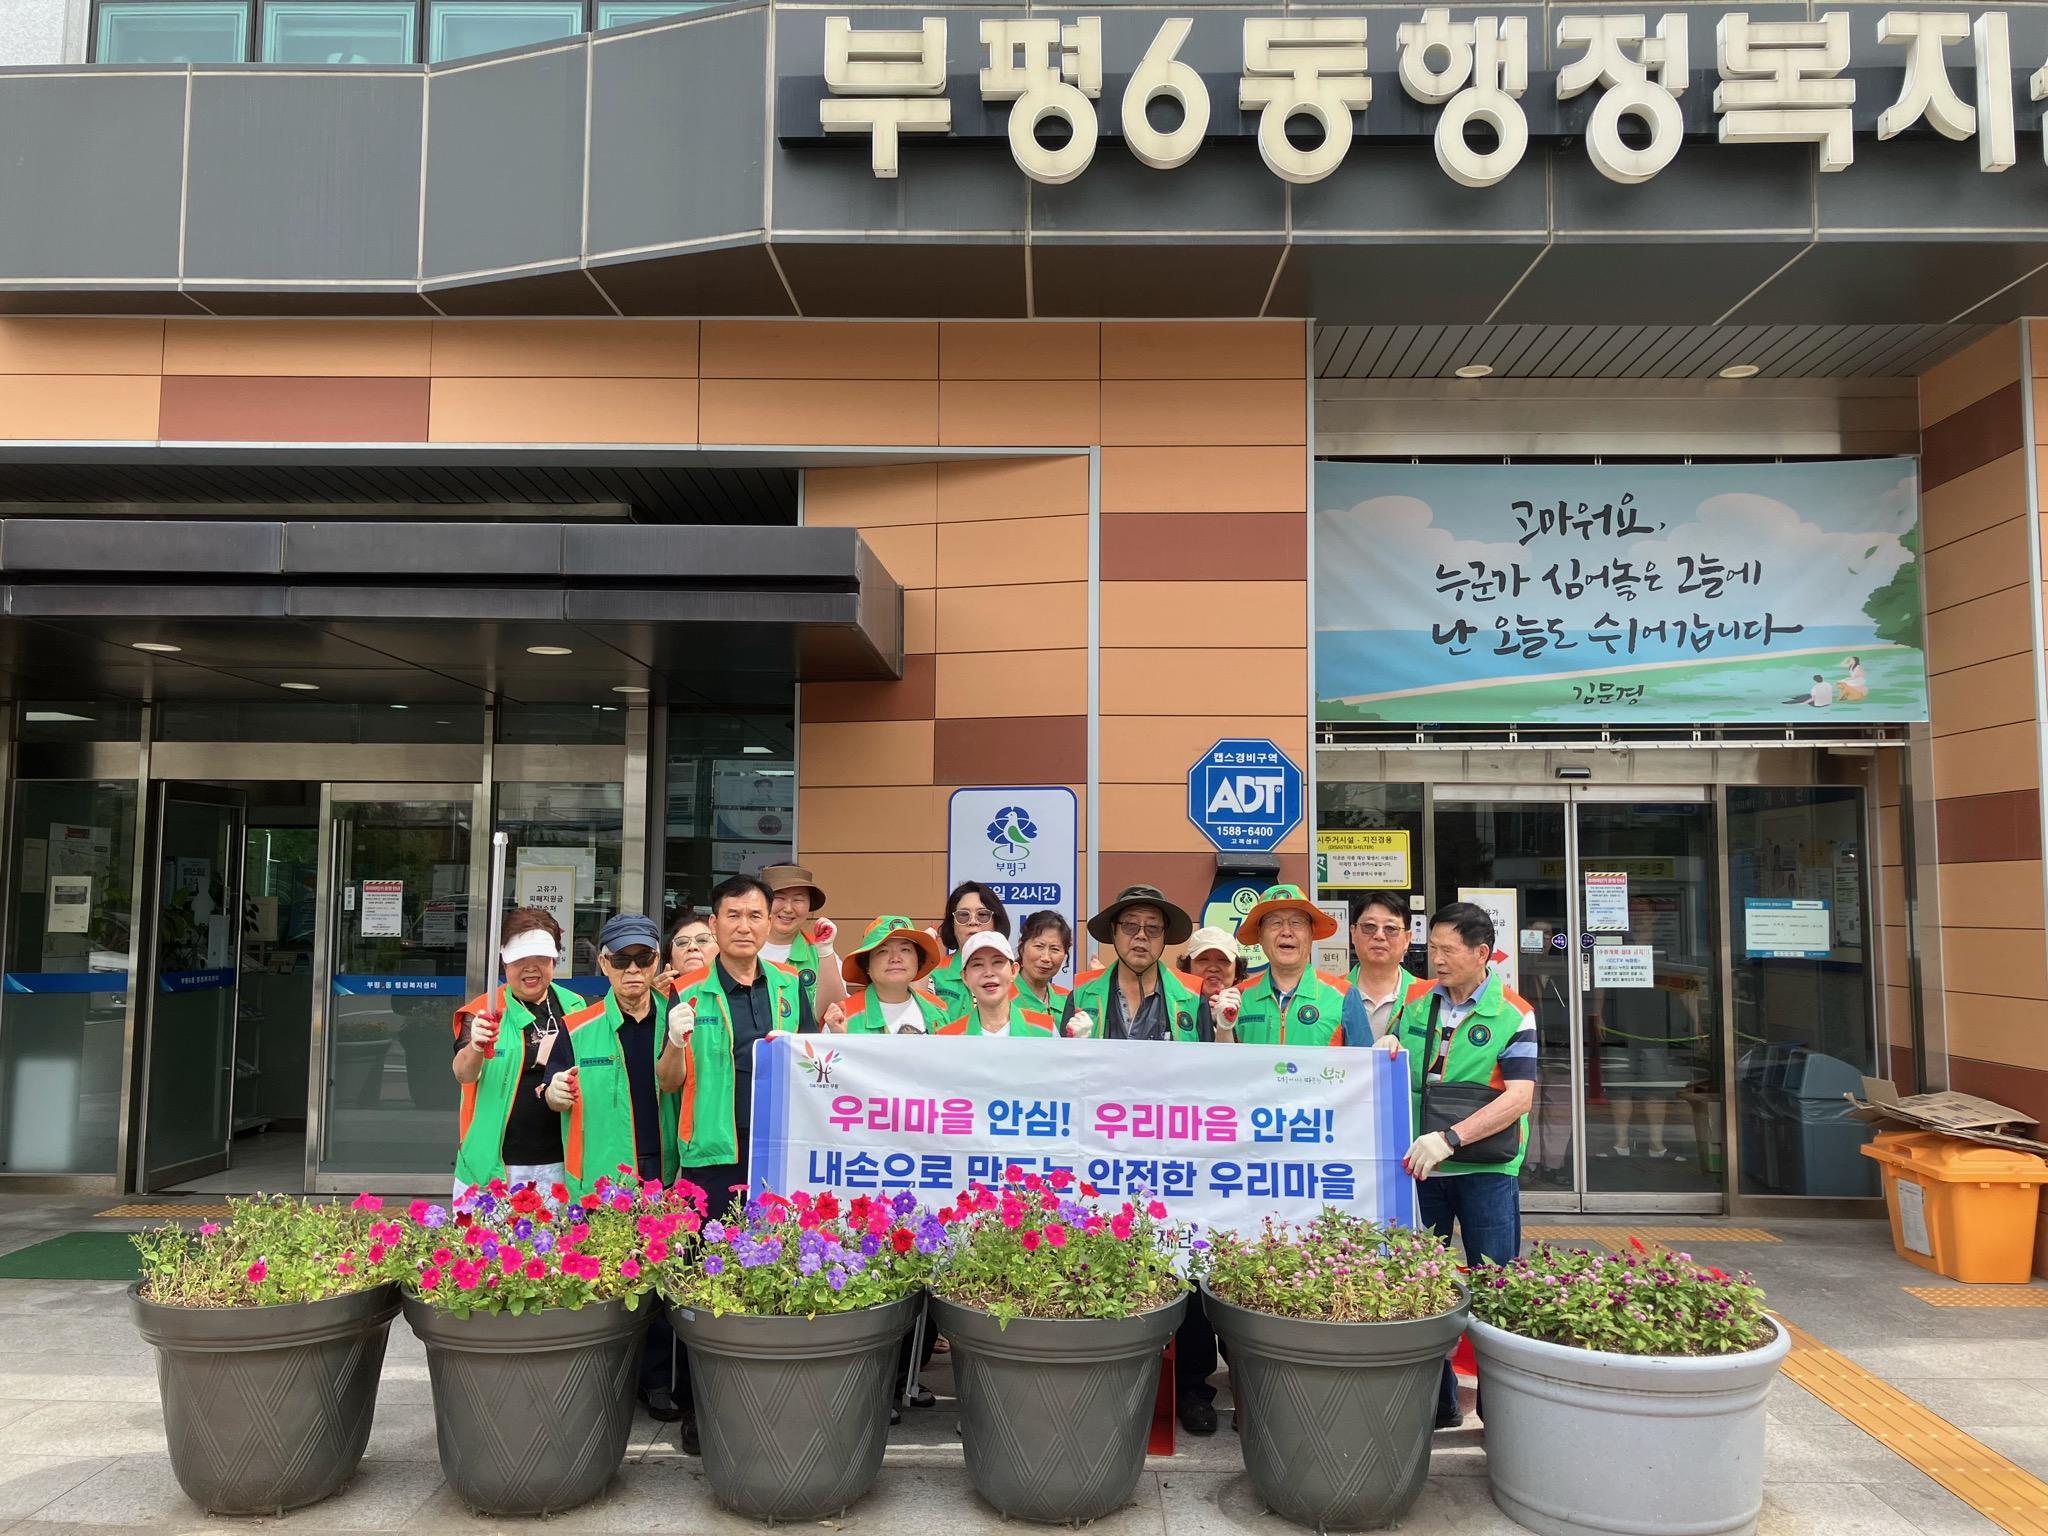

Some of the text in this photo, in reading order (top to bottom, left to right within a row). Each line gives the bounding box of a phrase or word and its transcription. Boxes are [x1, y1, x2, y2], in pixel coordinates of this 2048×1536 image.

[820, 8, 2048, 188] 부평6동행정복지
[1511, 492, 1666, 545] 고마워요,
[1435, 553, 1762, 602] 누군가 심어놓은 그늘에
[1432, 612, 1804, 660] 난 오늘도 쉬어갑니다
[1213, 752, 1278, 764] 캡스경비구역
[1207, 775, 1283, 814] ADT
[1216, 826, 1273, 837] 1588-6400
[1317, 836, 1354, 844] 시주거시설
[1362, 836, 1393, 844] 지진겸용
[996, 862, 1027, 877] 부평구
[536, 885, 557, 893] 고유가
[1011, 886, 1057, 901] 24시간
[529, 895, 564, 903] 피해지원금
[366, 981, 437, 989] 부평동 행정복지센터
[829, 1095, 1335, 1144] 우리마을 안심! 우리마음 안심!
[808, 1151, 953, 1189] 내손으로
[1087, 1158, 1198, 1197] 안전한
[1209, 1161, 1357, 1201] 우리마을
